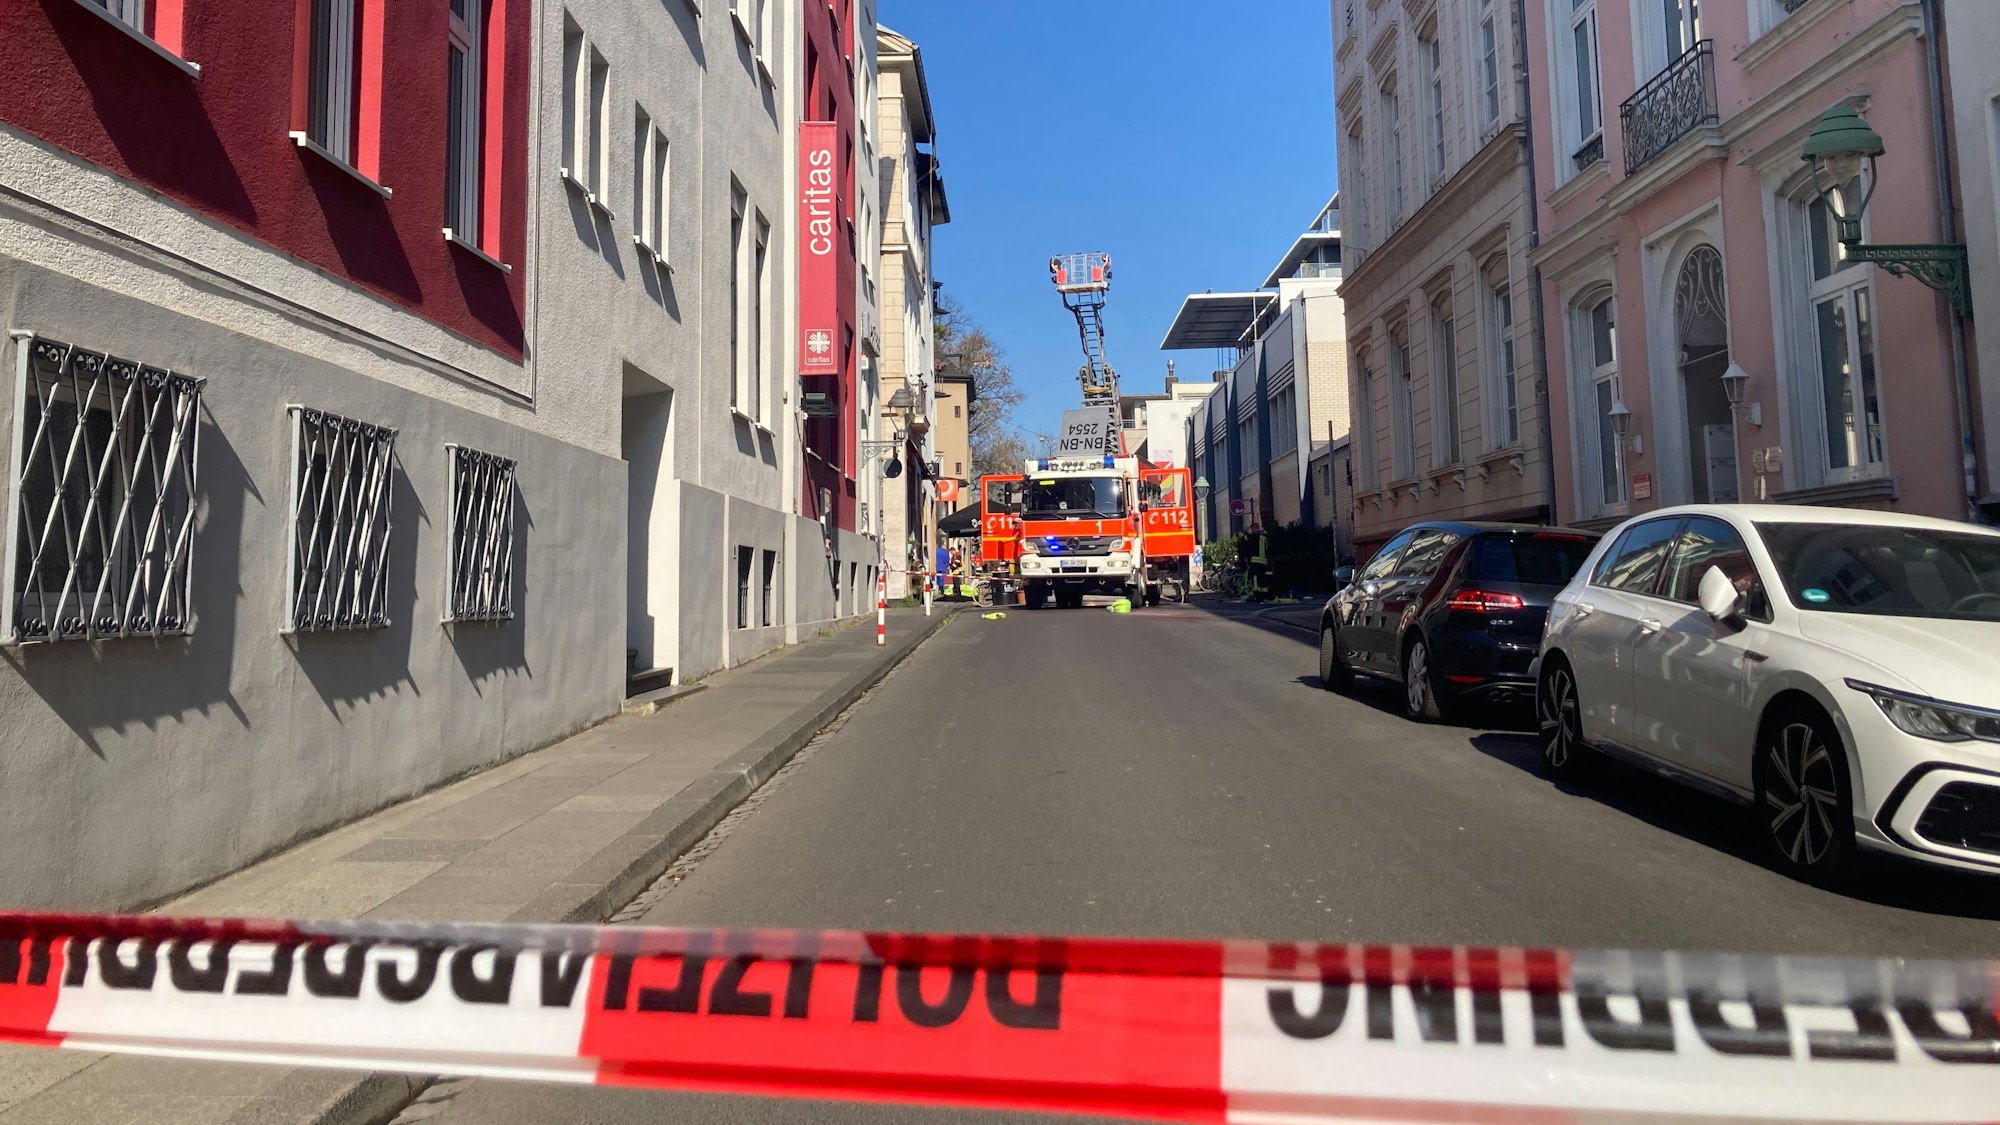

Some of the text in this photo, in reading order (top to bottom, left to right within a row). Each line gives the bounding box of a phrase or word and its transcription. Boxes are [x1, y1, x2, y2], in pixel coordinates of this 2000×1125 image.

[802, 149, 832, 256] caritas
[807, 356, 831, 364] caritas
[1068, 423, 1099, 436] 2554
[1059, 437, 1104, 451] BN-BN
[1161, 510, 1189, 524] 112
[1095, 519, 1102, 534] 1
